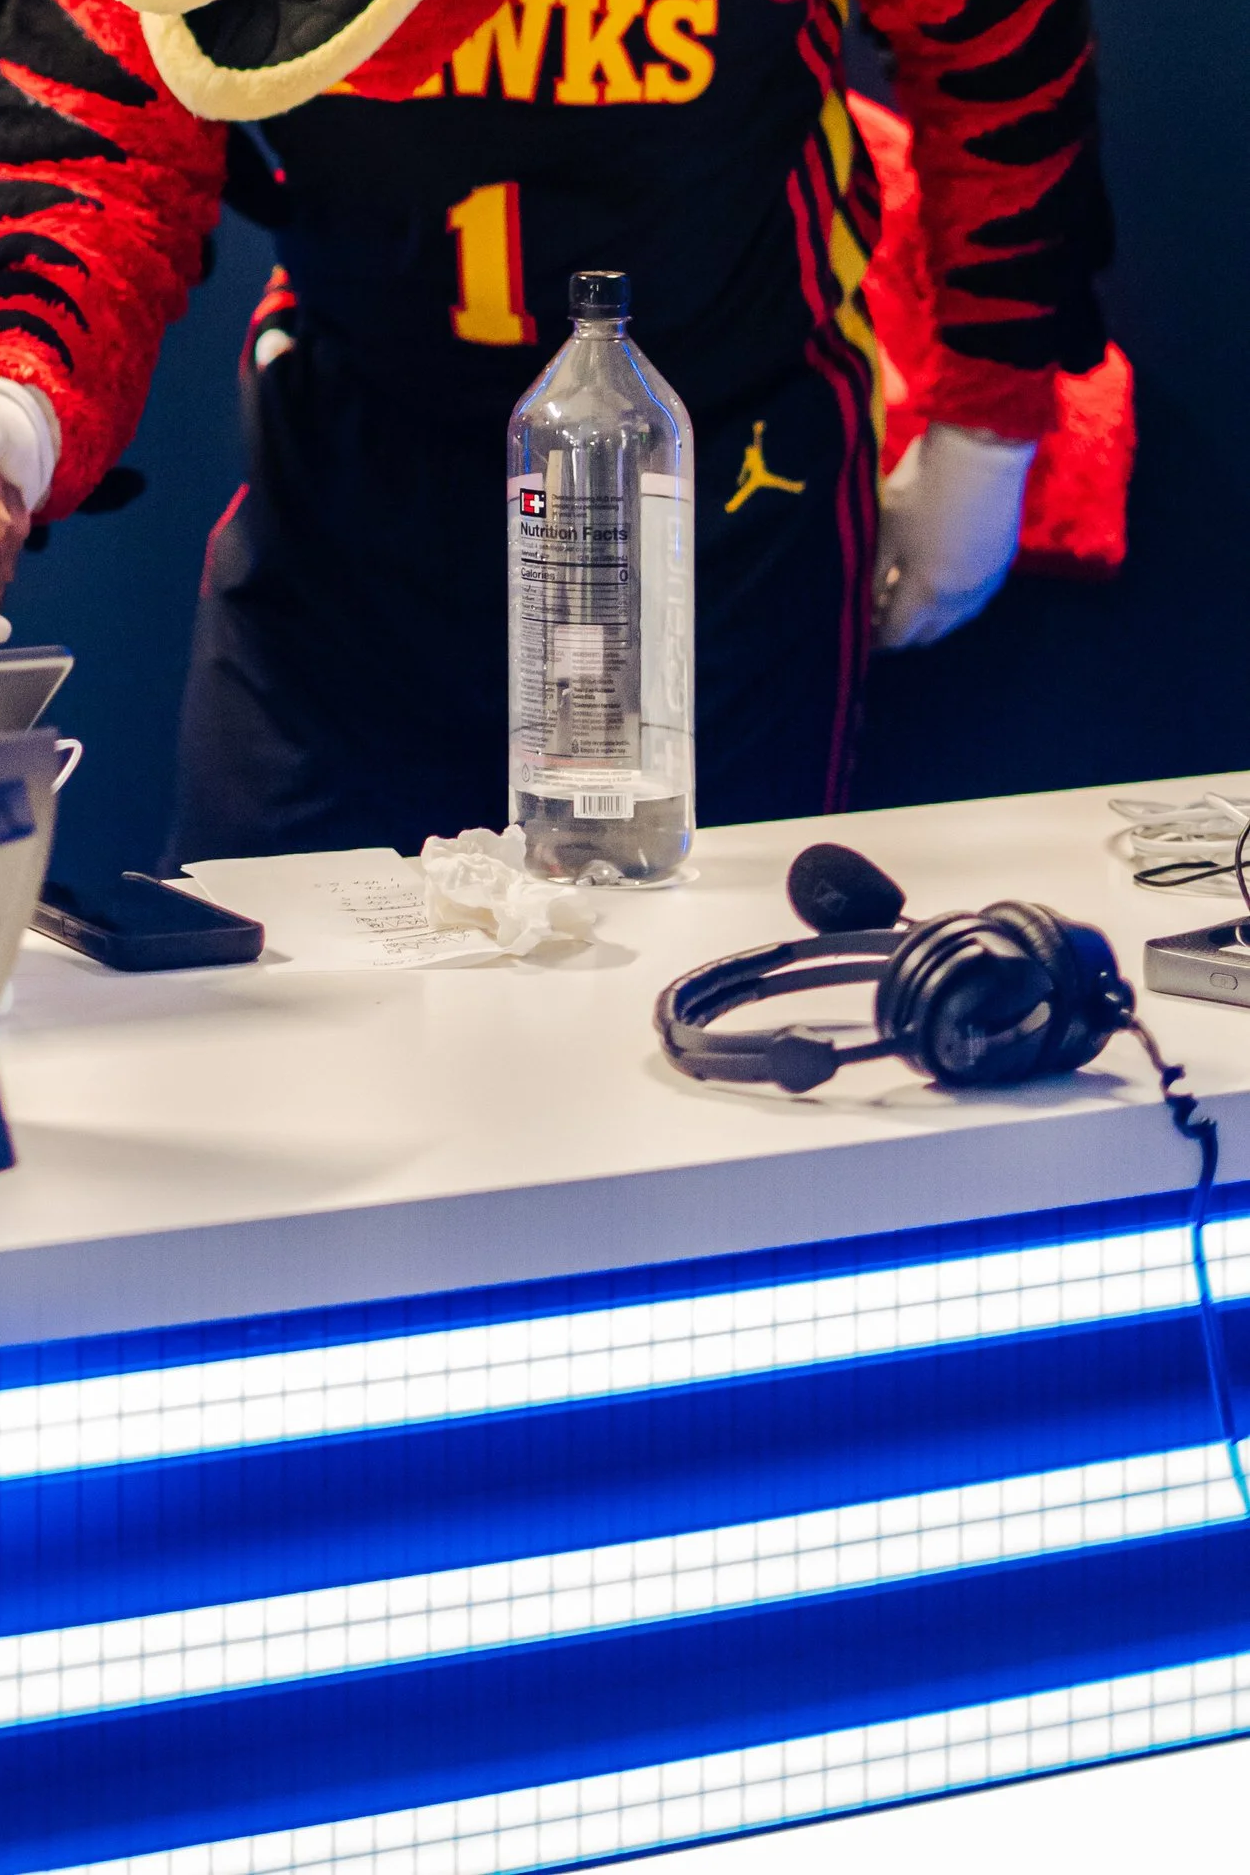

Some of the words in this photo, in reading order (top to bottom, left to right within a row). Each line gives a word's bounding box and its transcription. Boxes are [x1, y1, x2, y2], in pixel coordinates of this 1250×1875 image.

[446, 181, 538, 346] 1
[520, 521, 578, 541] Nutrition
[582, 526, 628, 541] Facts
[520, 566, 556, 581] Calories
[619, 569, 629, 582] 0
